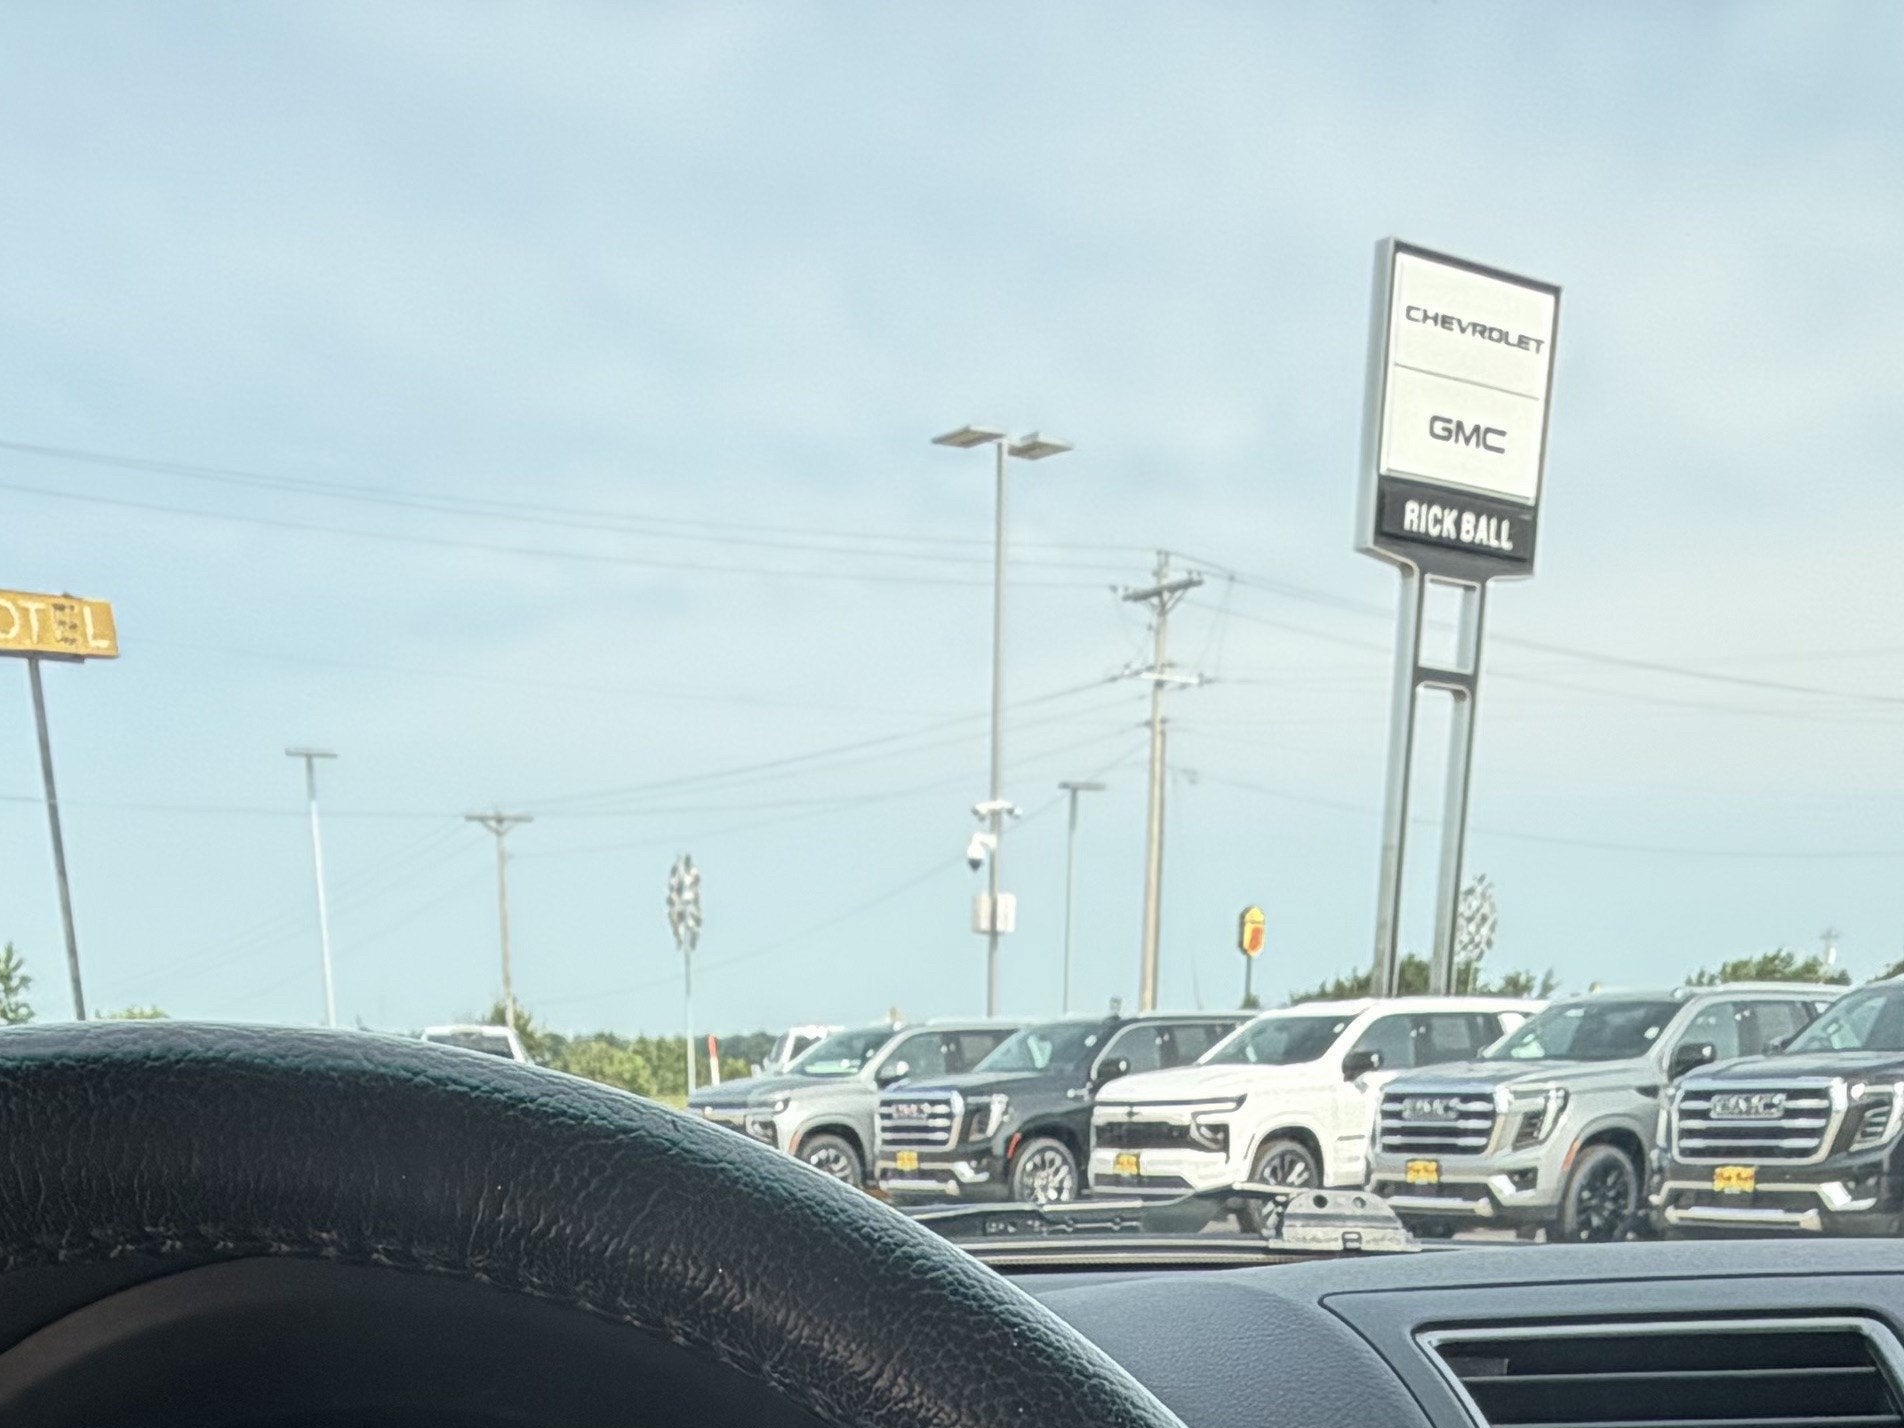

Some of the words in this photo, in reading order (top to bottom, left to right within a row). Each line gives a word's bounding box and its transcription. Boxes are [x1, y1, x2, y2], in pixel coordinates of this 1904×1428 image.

[1405, 305, 1545, 355] CHEVROLET
[1429, 415, 1507, 454] GMC
[1403, 500, 1457, 540] RICK
[1460, 511, 1514, 551] BALL
